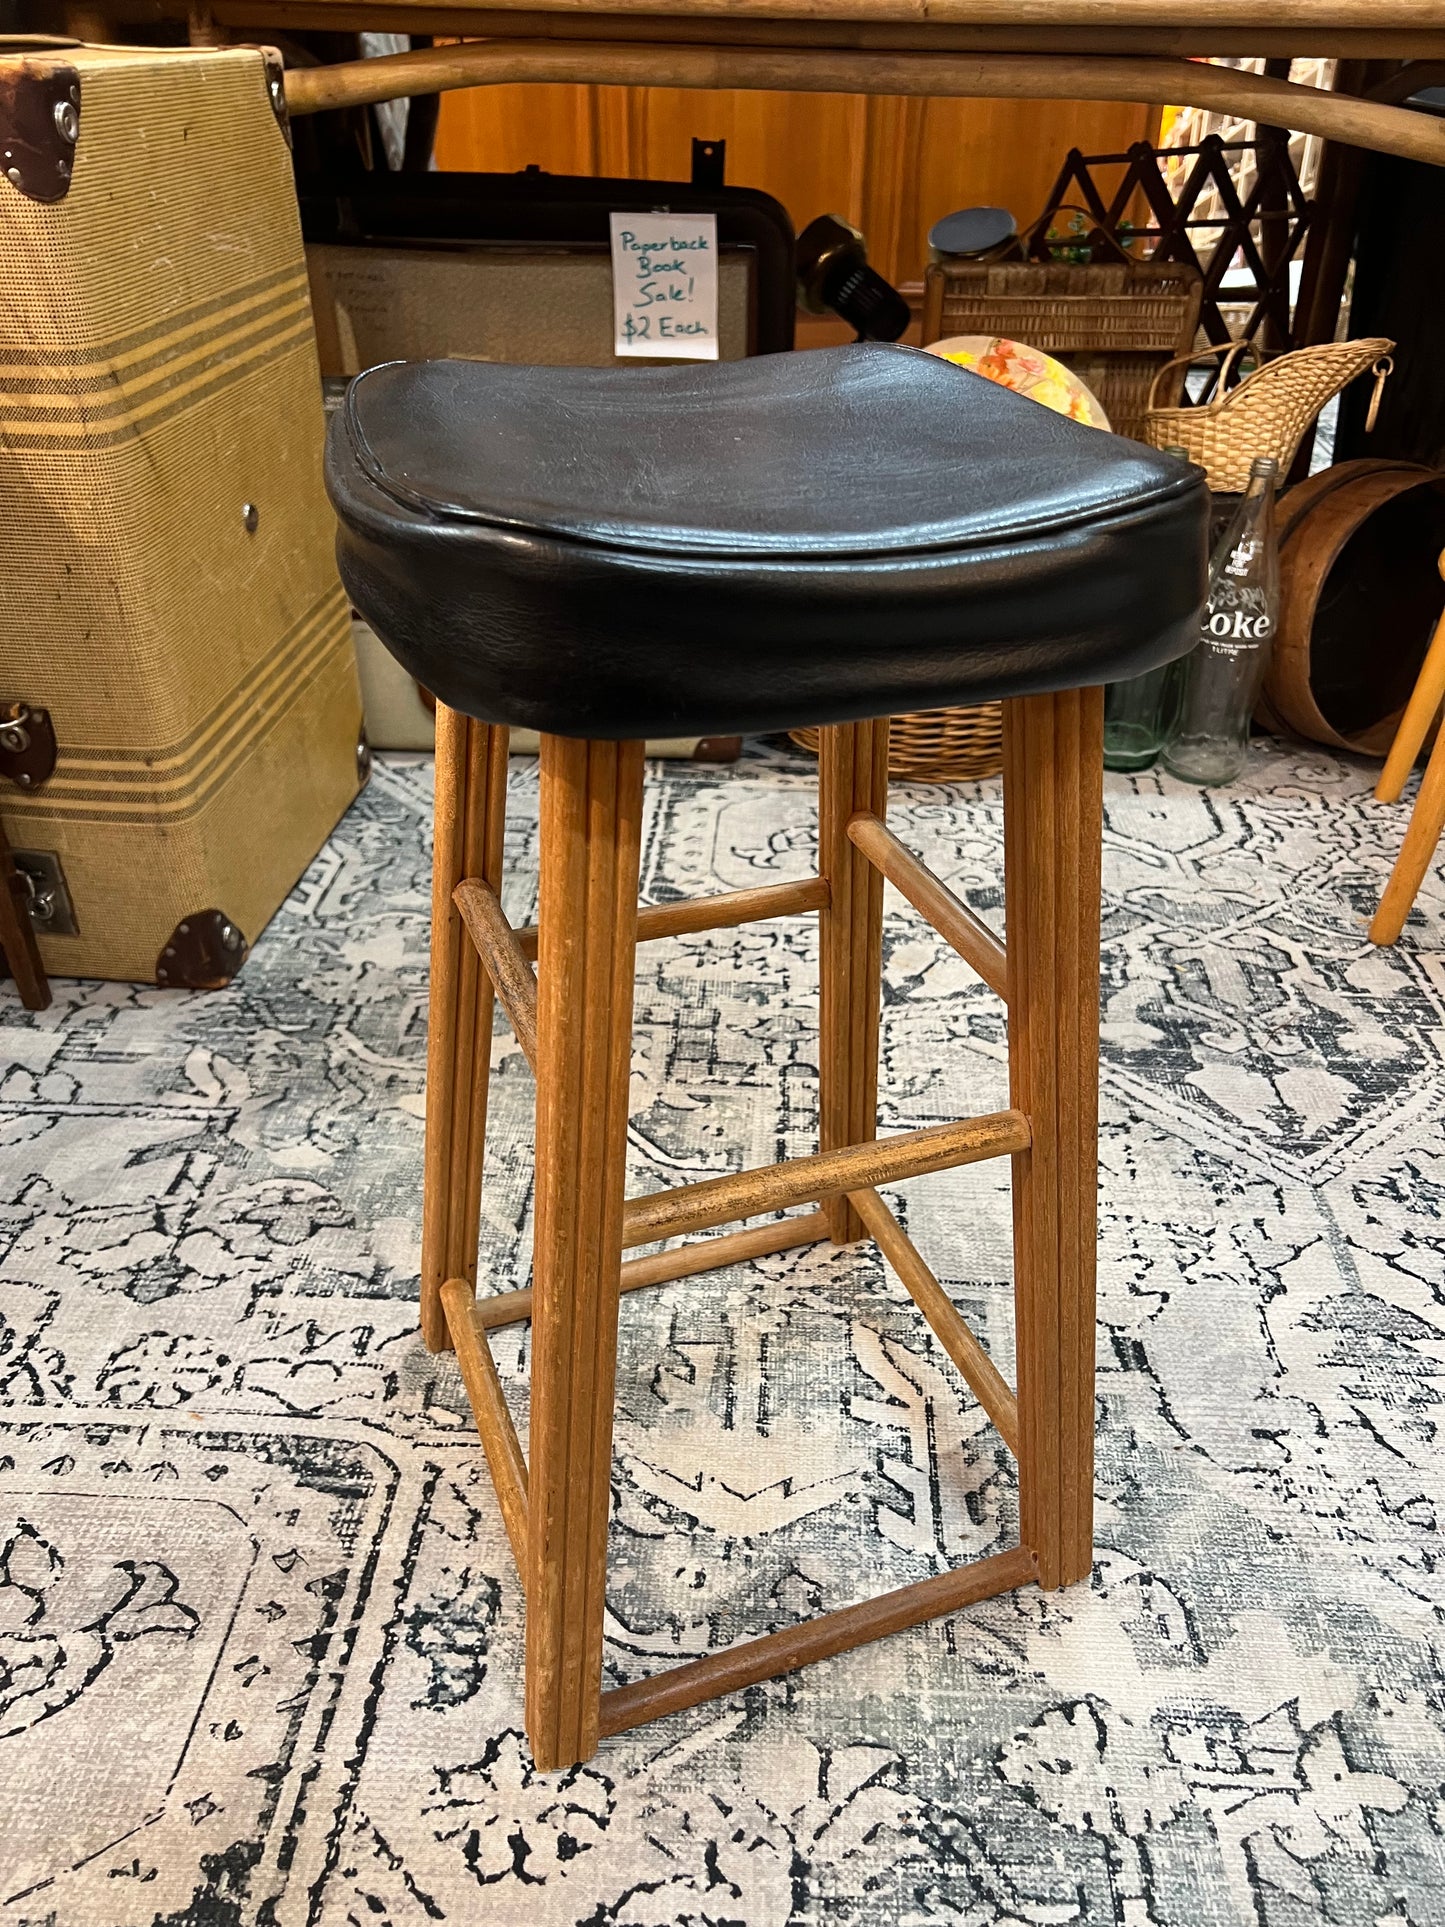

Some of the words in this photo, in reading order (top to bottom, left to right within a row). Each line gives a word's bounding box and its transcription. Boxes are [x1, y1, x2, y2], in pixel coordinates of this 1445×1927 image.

[620, 231, 709, 255] Paperback
[636, 256, 687, 279] Book
[633, 277, 695, 308] Sale!
[621, 313, 651, 346] $2
[659, 316, 709, 338] Each
